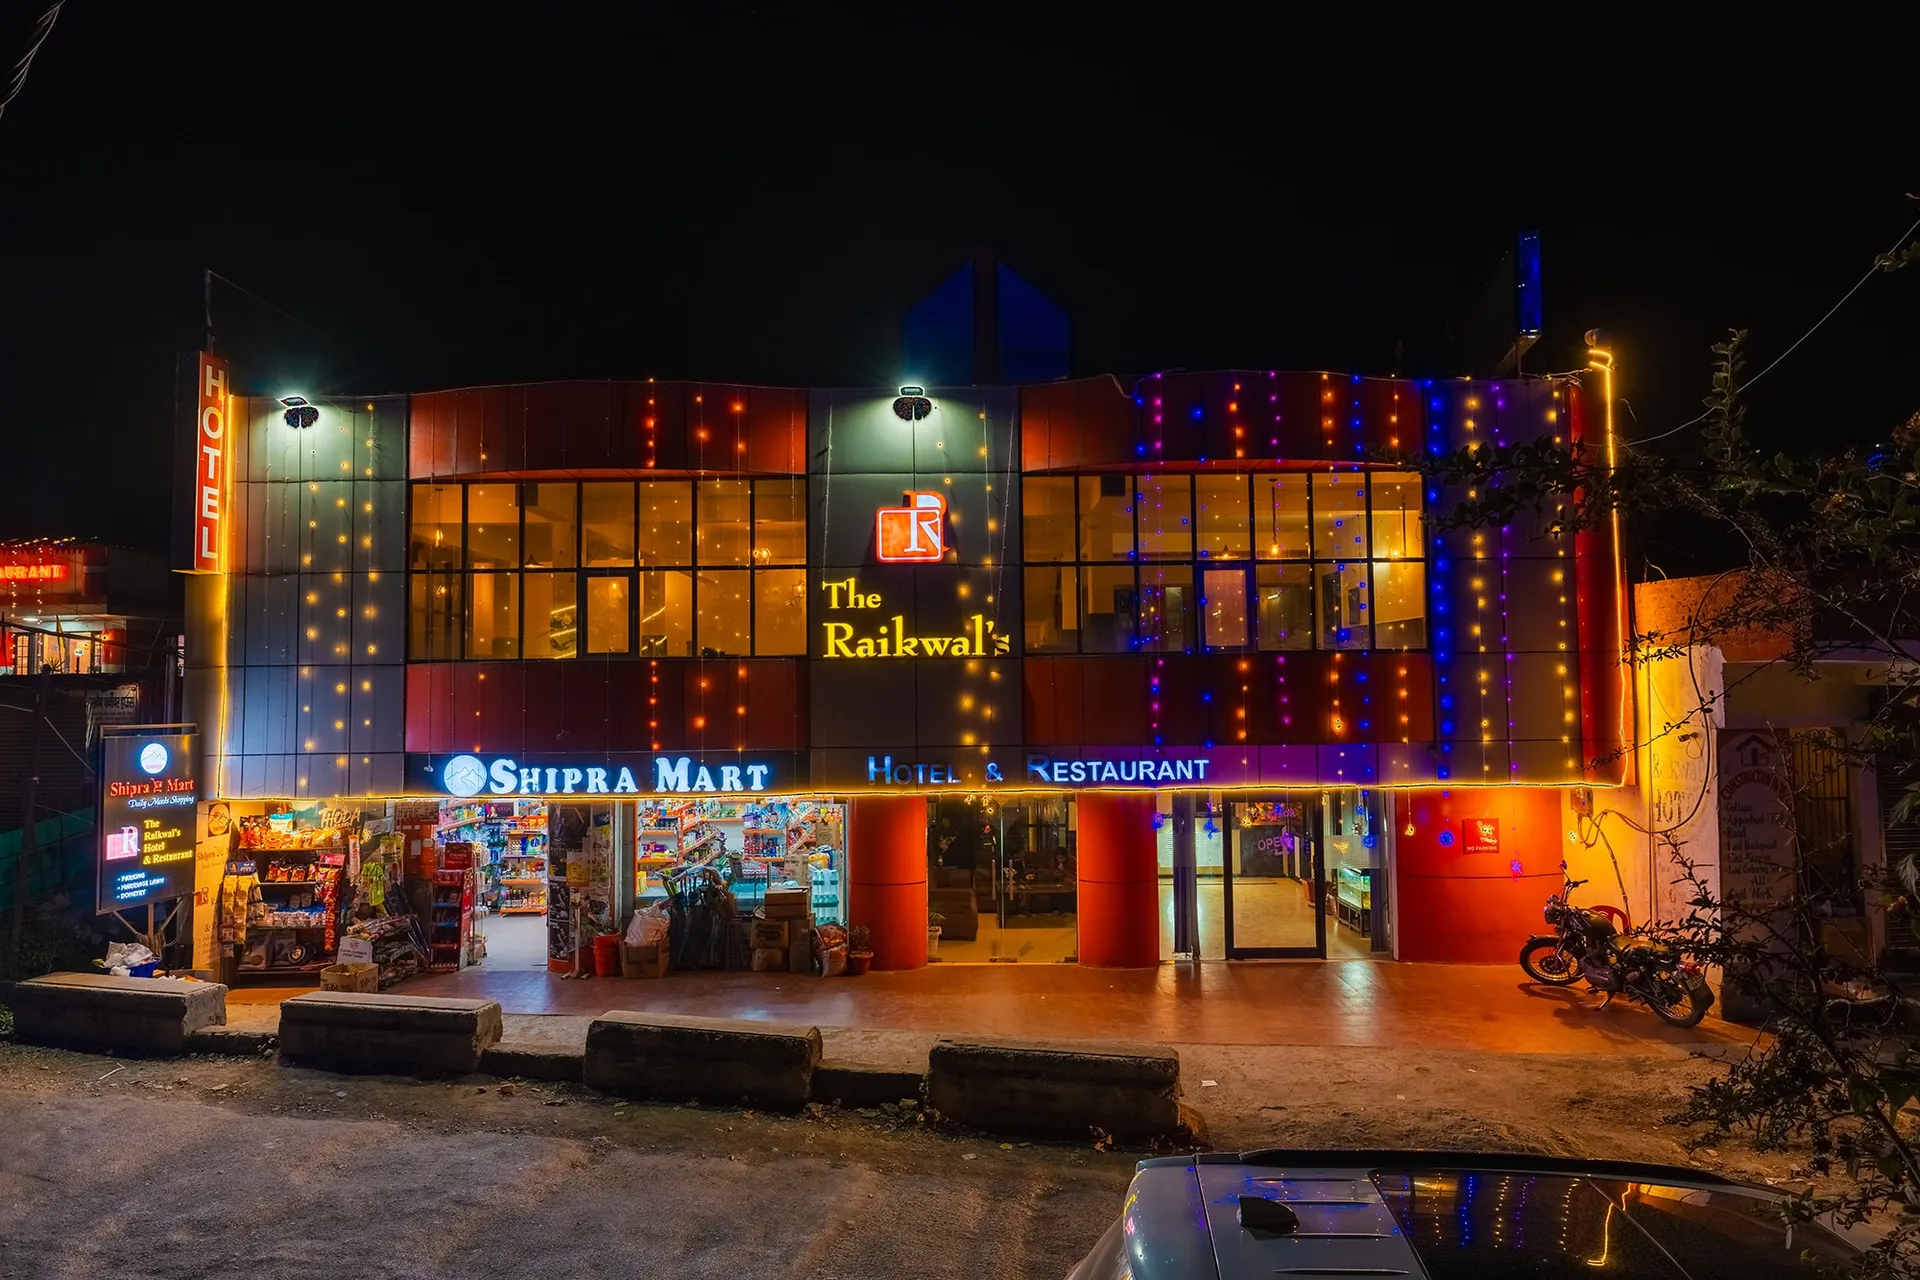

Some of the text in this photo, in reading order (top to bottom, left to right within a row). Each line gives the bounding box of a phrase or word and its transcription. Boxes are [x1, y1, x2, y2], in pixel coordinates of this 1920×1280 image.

[202, 364, 224, 559] HOTEL
[822, 578, 882, 609] The
[823, 614, 1010, 657] Raikwal's
[489, 757, 768, 795] SHIPRA MART
[867, 754, 1210, 786] HOTEL & RESTAURANT
[110, 778, 195, 798] Shipra Mart
[128, 799, 147, 809] Daily
[170, 796, 195, 806] Shopping
[144, 820, 160, 829] The
[144, 828, 181, 840] Raikwal's
[144, 842, 165, 853] Hotel
[143, 850, 193, 865] & Restaurant
[121, 872, 145, 882] PARKING
